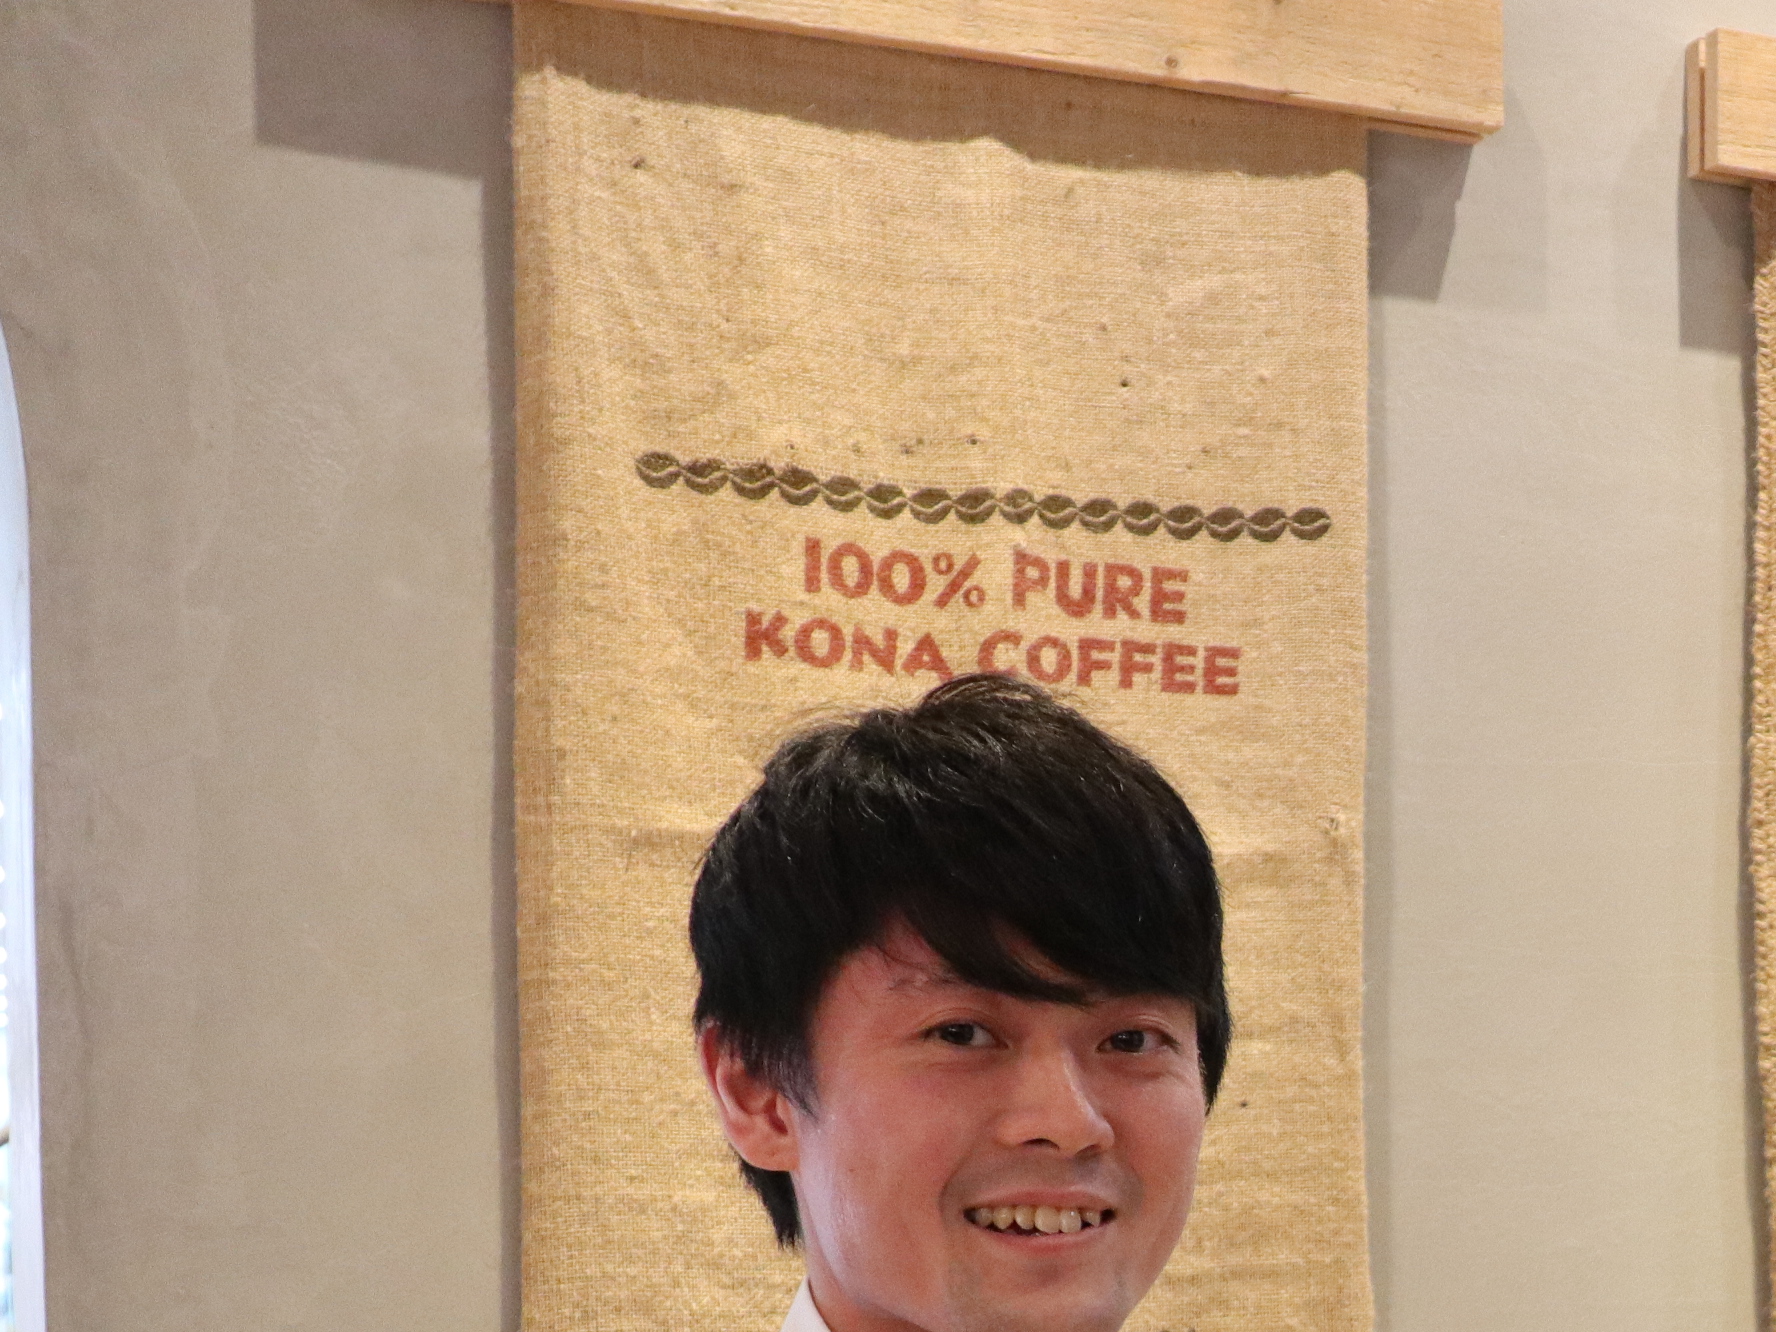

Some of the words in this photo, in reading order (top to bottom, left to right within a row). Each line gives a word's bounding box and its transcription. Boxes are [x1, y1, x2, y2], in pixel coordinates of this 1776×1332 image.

[803, 536, 987, 609] 100%
[1012, 544, 1190, 624] PURE
[743, 607, 954, 682] KONA
[977, 629, 1243, 695] COFFEE
